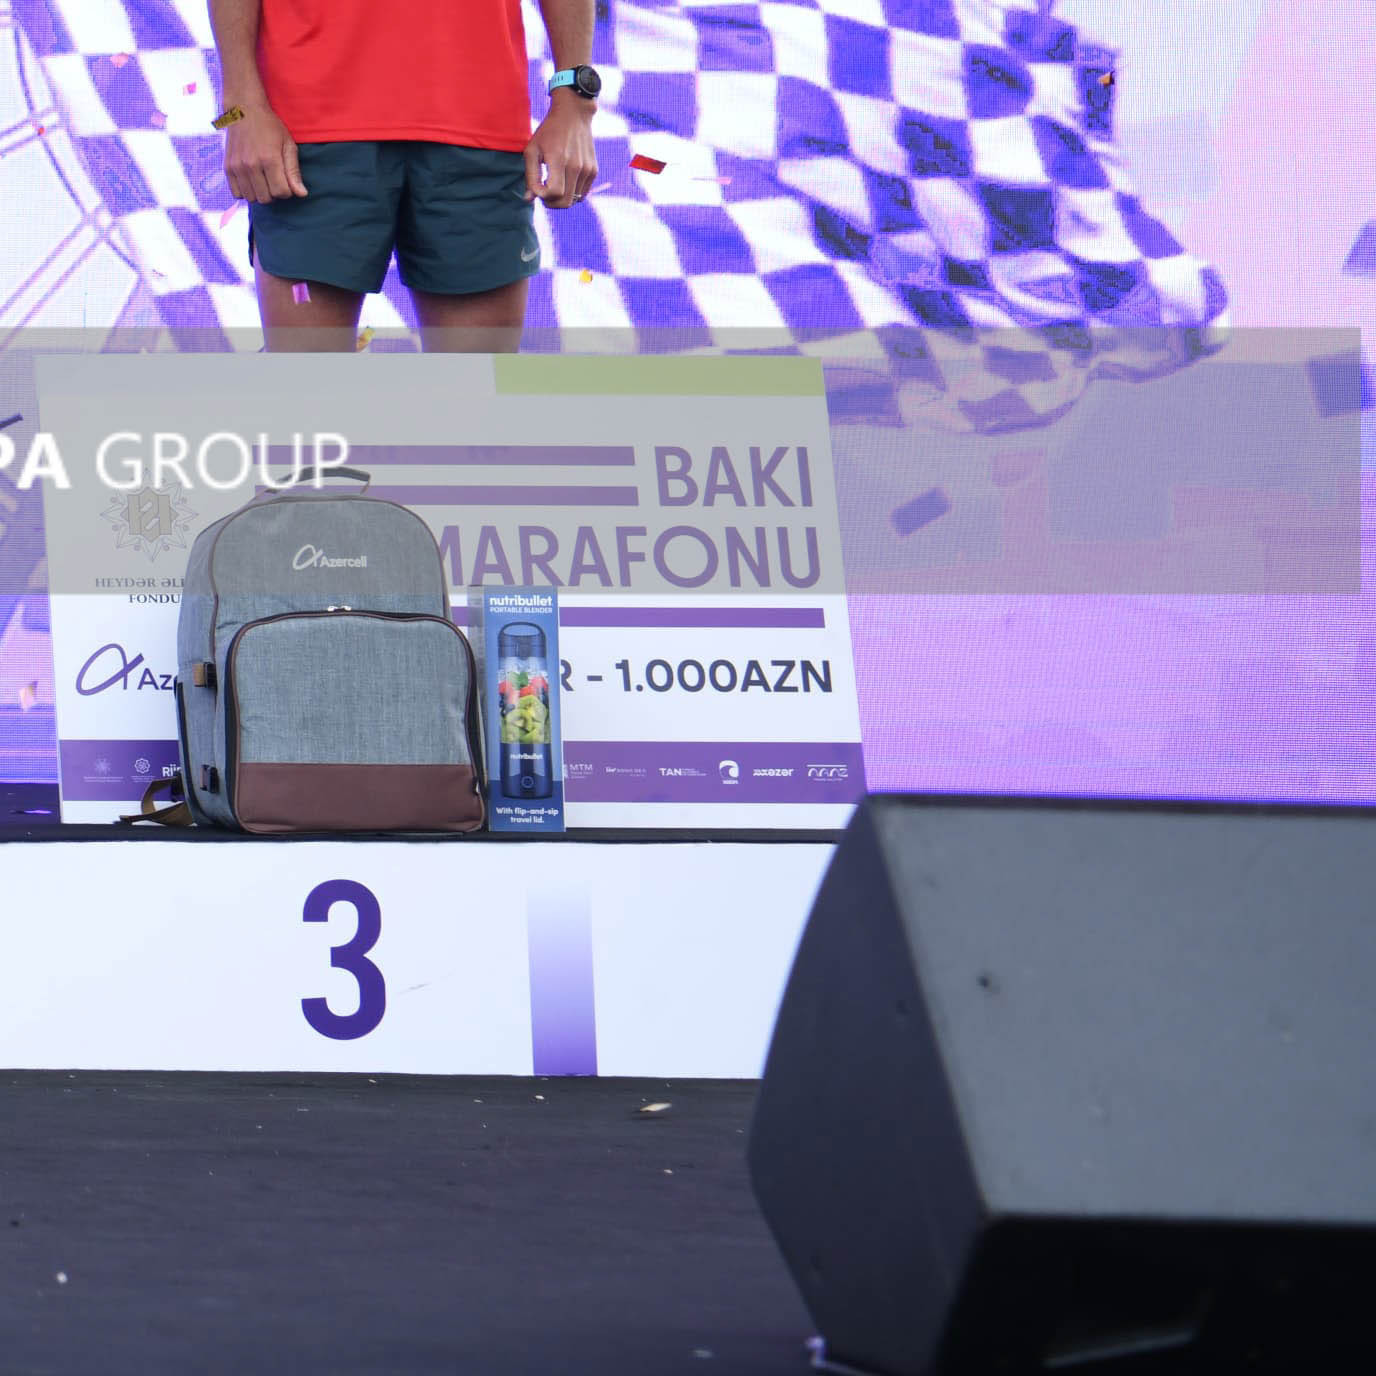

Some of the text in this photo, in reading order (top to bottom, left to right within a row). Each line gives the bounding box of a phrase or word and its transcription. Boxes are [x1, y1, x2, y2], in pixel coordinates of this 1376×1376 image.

[654, 446, 813, 507] BAKI
[320, 555, 367, 568] Azercell
[129, 593, 181, 604] FONDU
[489, 595, 553, 606] nutribullet
[615, 659, 833, 693] 1.000AZN
[659, 768, 682, 776] TAN
[301, 879, 386, 1040] 3
